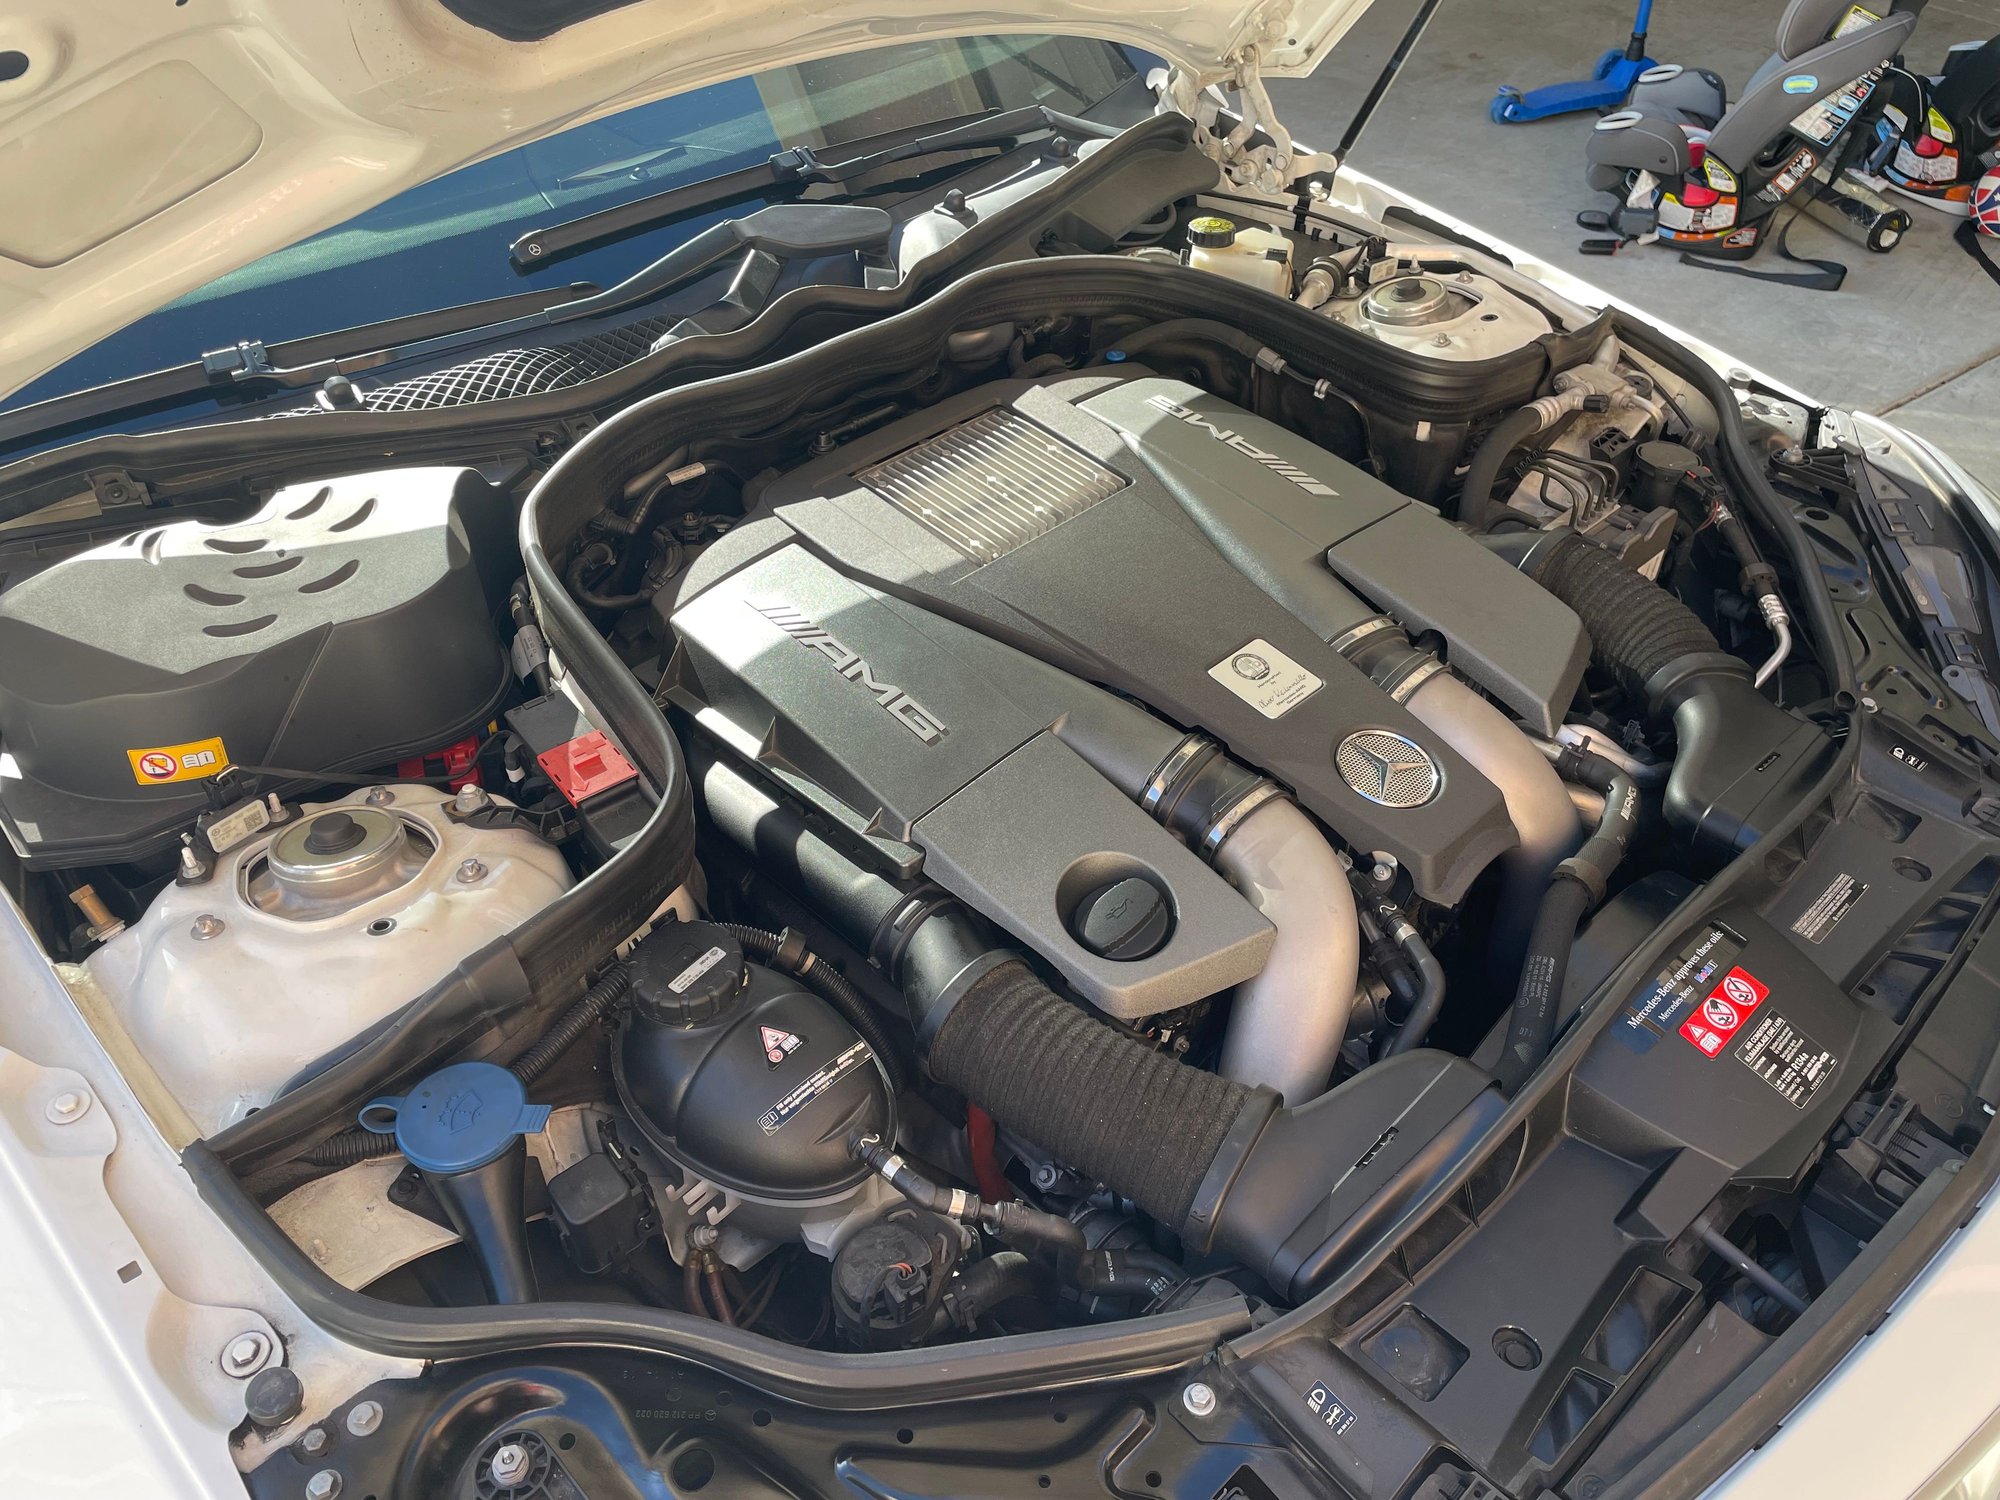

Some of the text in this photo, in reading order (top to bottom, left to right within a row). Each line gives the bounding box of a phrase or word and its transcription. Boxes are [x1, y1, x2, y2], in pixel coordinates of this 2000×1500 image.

[791, 628, 948, 744] AMG
[1286, 691, 1304, 704] Germany
[1626, 928, 1724, 1029] Mercedes-Benz approves these oils:
[1657, 983, 1695, 1022] Mercedes-Benz
[1743, 1017, 1773, 1050] AIR CONDITIONER
[1744, 1033, 1770, 1062] KLIMAANLAGE
[1790, 1050, 1809, 1071] R134a
